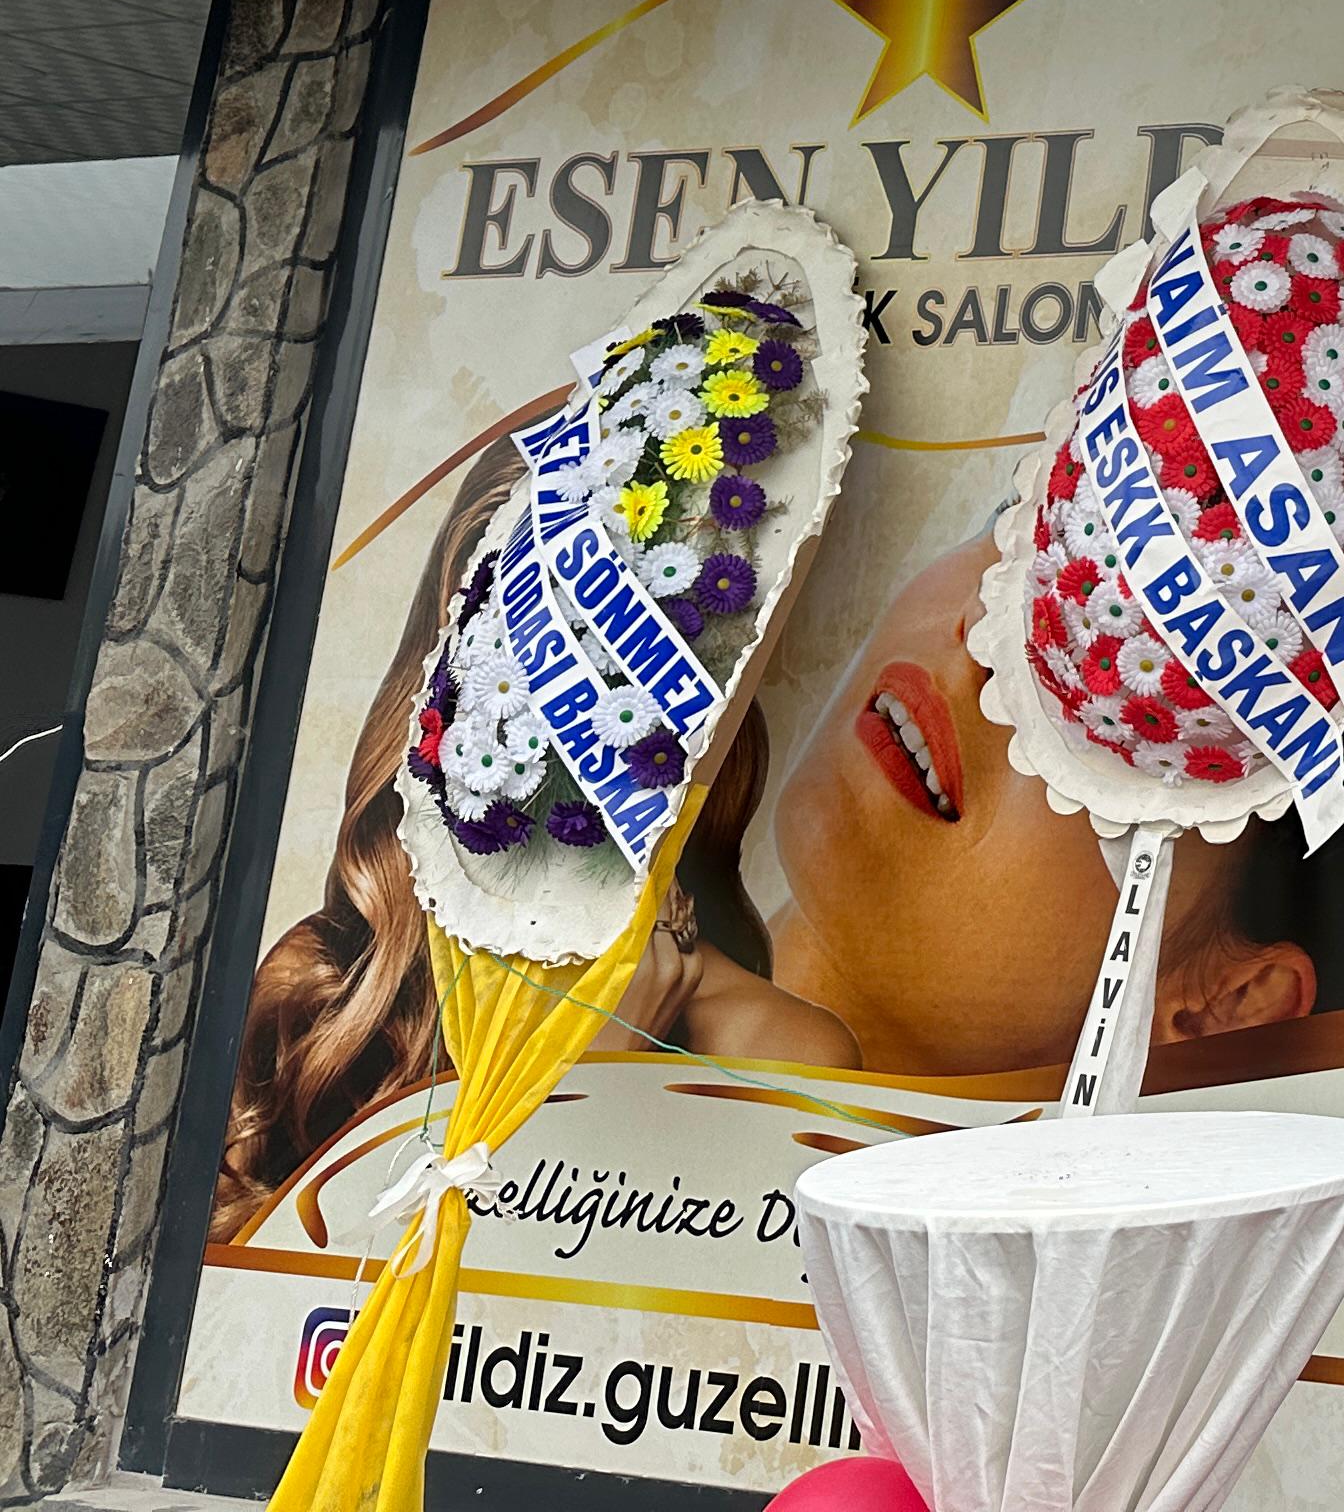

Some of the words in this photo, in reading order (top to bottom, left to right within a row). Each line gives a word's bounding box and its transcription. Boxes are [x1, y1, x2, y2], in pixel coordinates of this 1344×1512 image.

[911, 281, 1105, 346] SALON
[555, 527, 715, 736] SÖNMEZ
[1085, 403, 1176, 570] ESKK
[1144, 553, 1341, 799] BAŞKANI
[538, 676, 671, 865] BAŞKA
[443, 1323, 861, 1451] ildiz.guzelli
